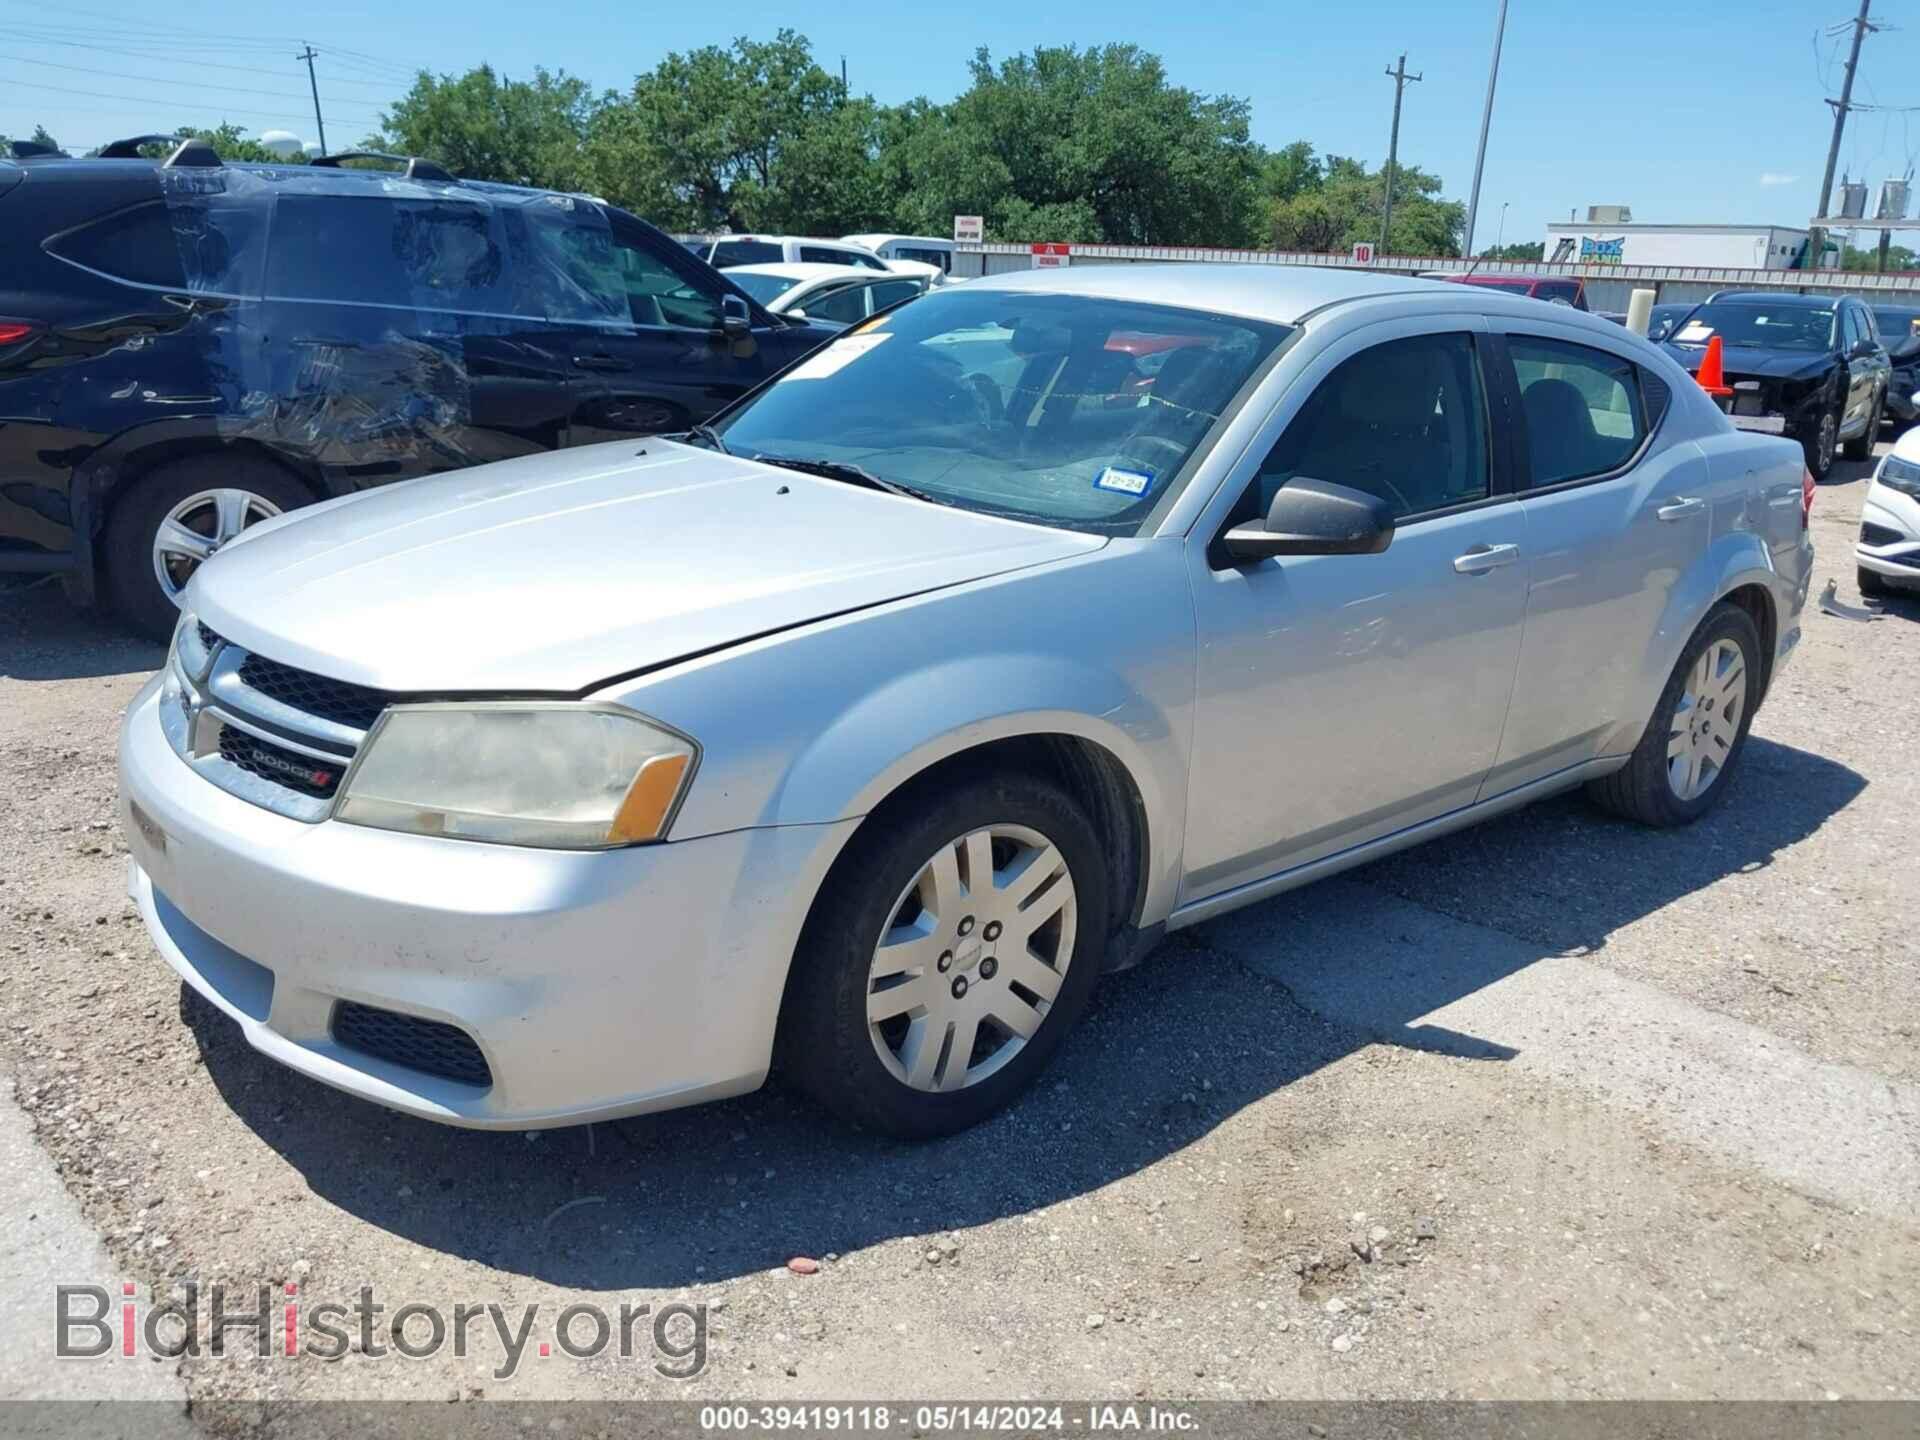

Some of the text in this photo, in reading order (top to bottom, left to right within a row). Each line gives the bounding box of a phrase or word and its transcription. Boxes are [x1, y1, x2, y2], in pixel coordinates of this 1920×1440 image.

[1355, 246, 1370, 262] 10
[1581, 237, 1624, 255] BOX
[252, 750, 313, 779] DODGE
